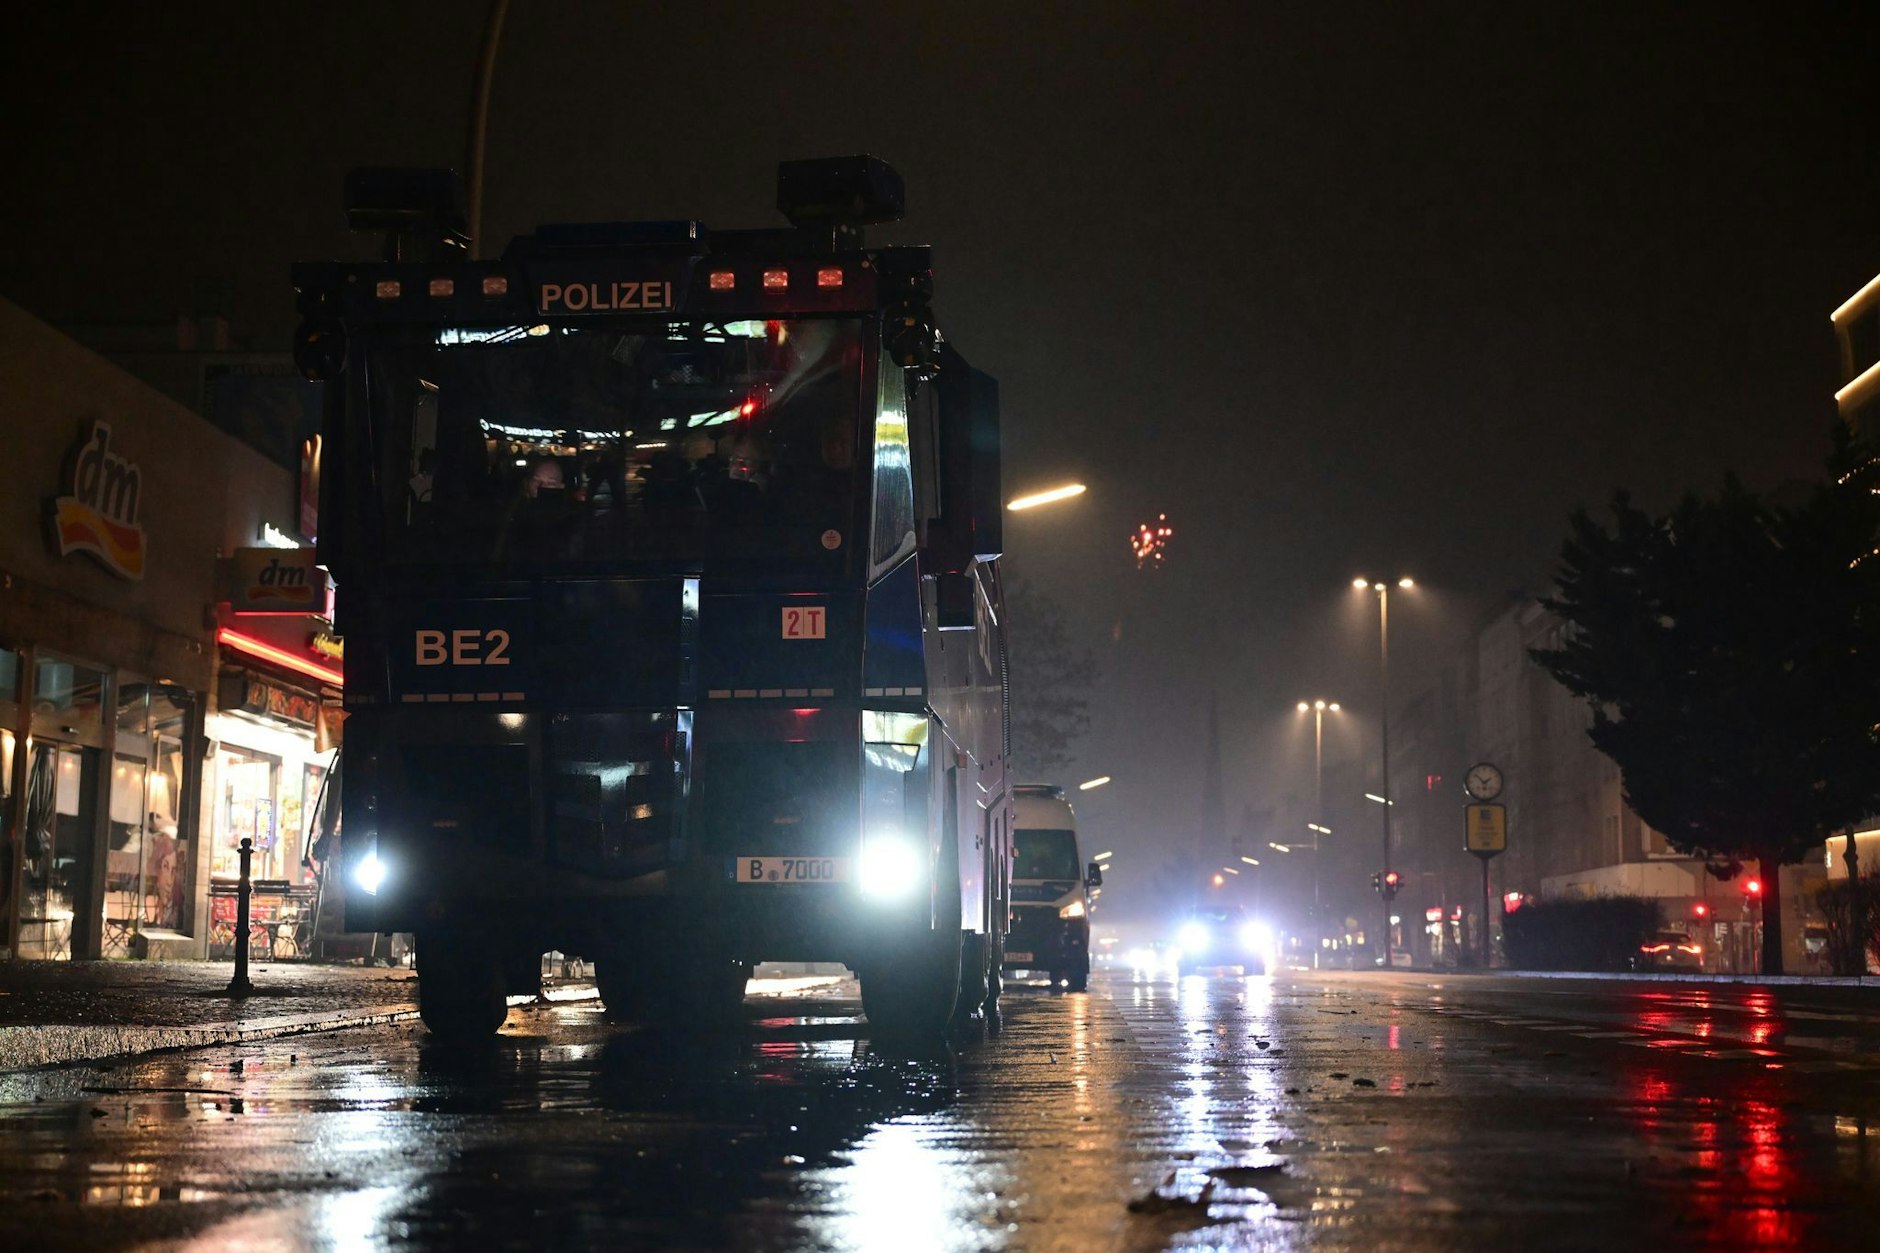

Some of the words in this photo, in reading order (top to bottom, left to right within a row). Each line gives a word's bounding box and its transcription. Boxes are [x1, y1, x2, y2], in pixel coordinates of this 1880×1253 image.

[541, 281, 672, 311] POLIZEI
[73, 419, 142, 527] dm
[257, 558, 305, 586] dm
[415, 629, 511, 665] BE2
[750, 859, 763, 880] B
[782, 859, 834, 880] 7000
